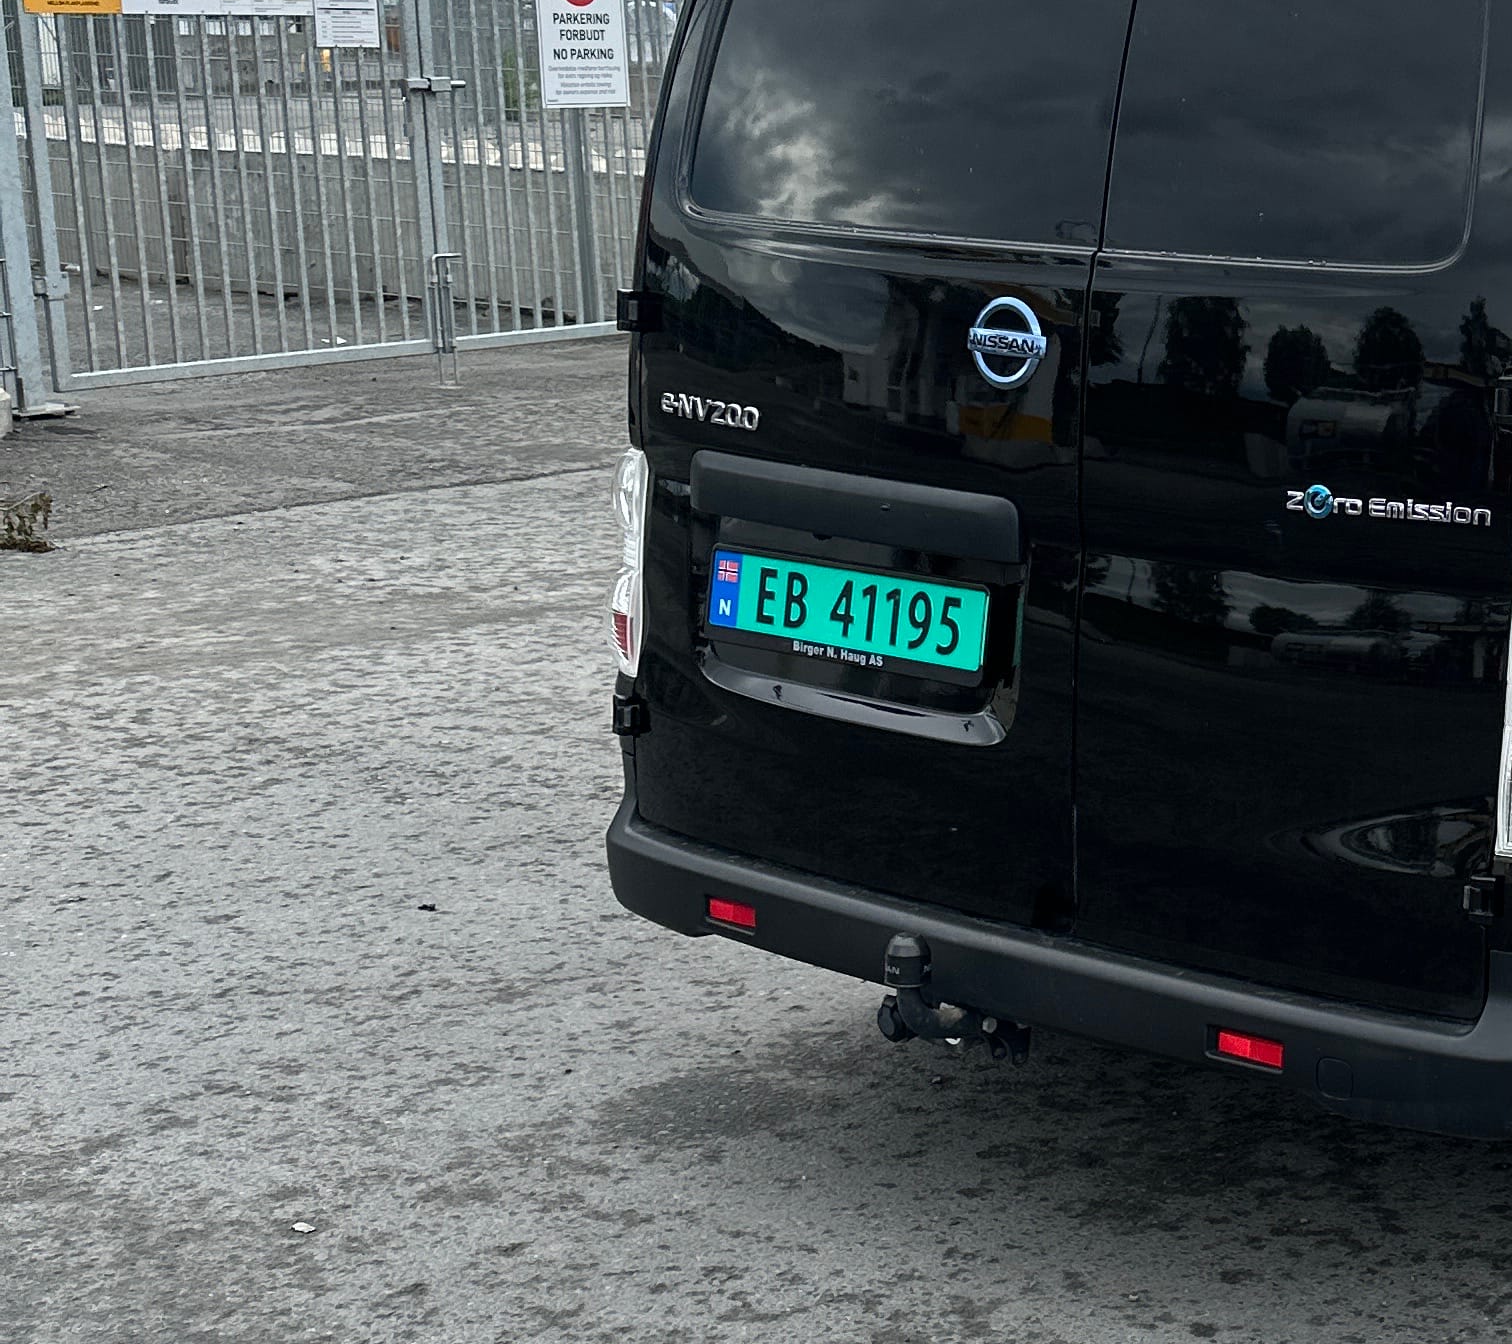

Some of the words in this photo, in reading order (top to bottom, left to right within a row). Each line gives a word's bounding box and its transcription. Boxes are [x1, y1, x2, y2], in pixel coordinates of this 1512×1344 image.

[552, 12, 611, 25] PARKERING
[559, 29, 606, 41] FORBUDT
[552, 48, 568, 60] NO
[570, 48, 615, 60] PARKING
[972, 333, 1036, 354] NISSAN
[660, 390, 760, 432] e-NV200
[718, 598, 732, 617] N
[755, 567, 809, 629] EB
[829, 579, 963, 656] 41195
[793, 640, 825, 657] Birger
[826, 646, 838, 659] N.
[840, 648, 867, 666] Haug
[868, 655, 884, 667] AS
